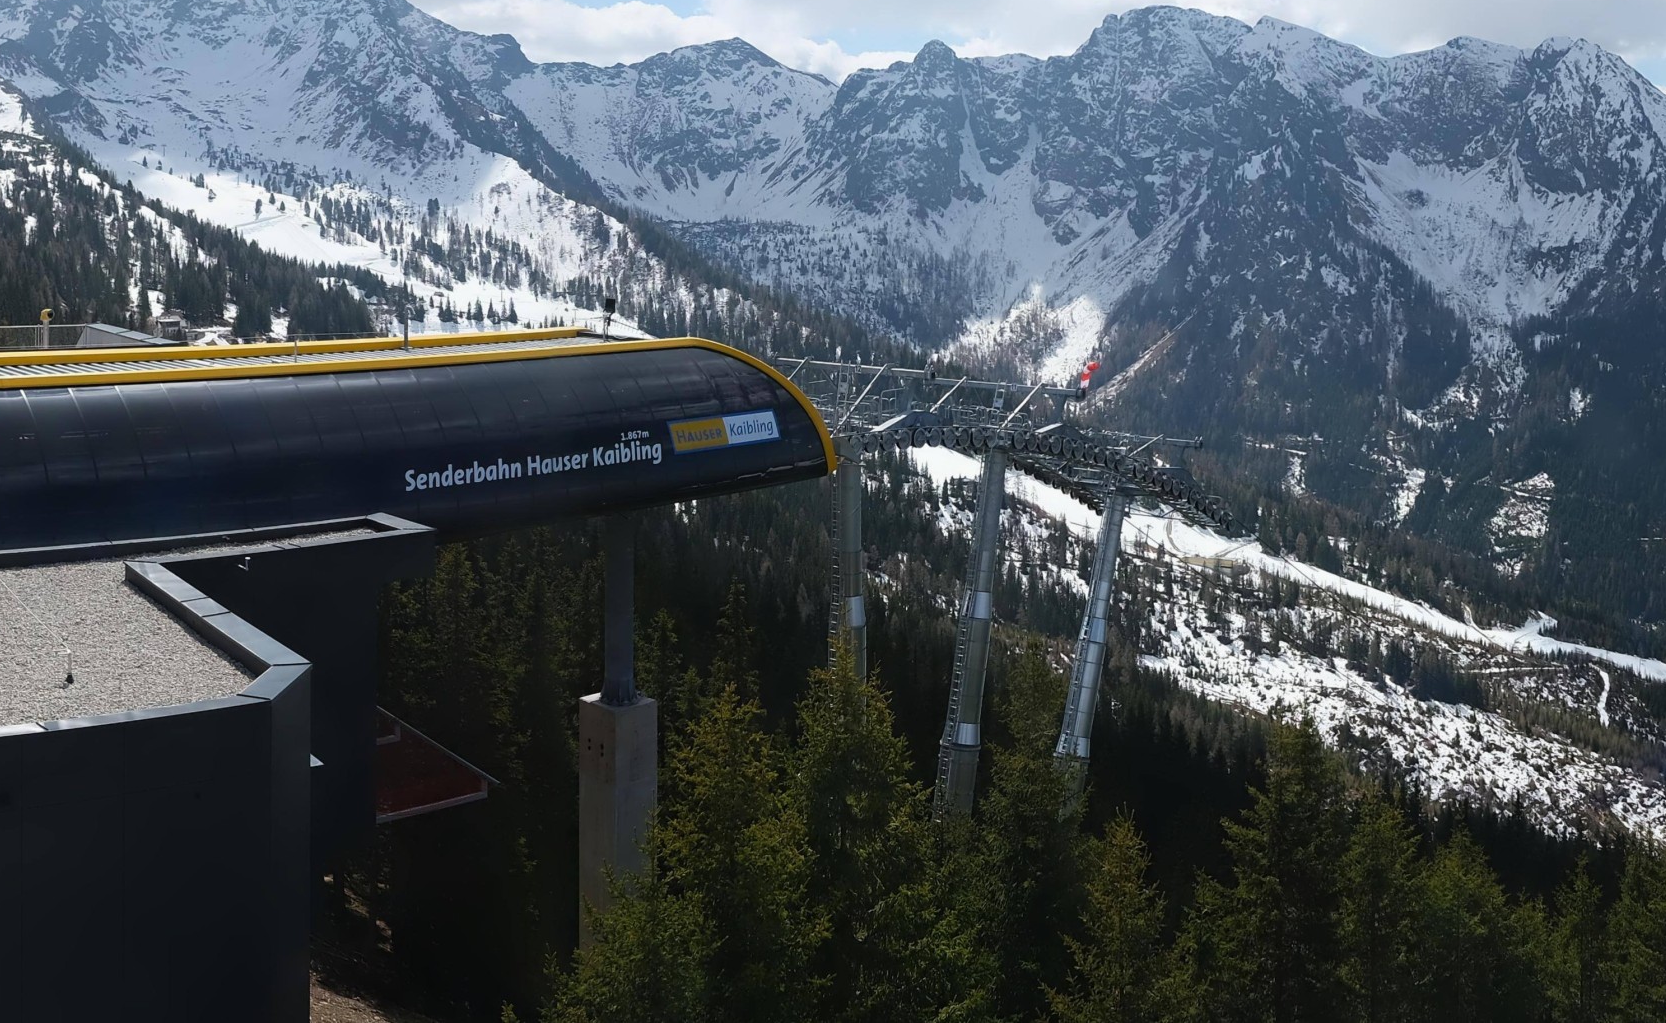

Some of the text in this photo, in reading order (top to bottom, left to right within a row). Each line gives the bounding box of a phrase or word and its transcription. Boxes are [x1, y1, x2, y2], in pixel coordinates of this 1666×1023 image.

[620, 430, 649, 441] 1.867m
[676, 416, 774, 444] HAUSER Kaibling
[405, 439, 663, 492] Senderbahn Hauser Kaibling
